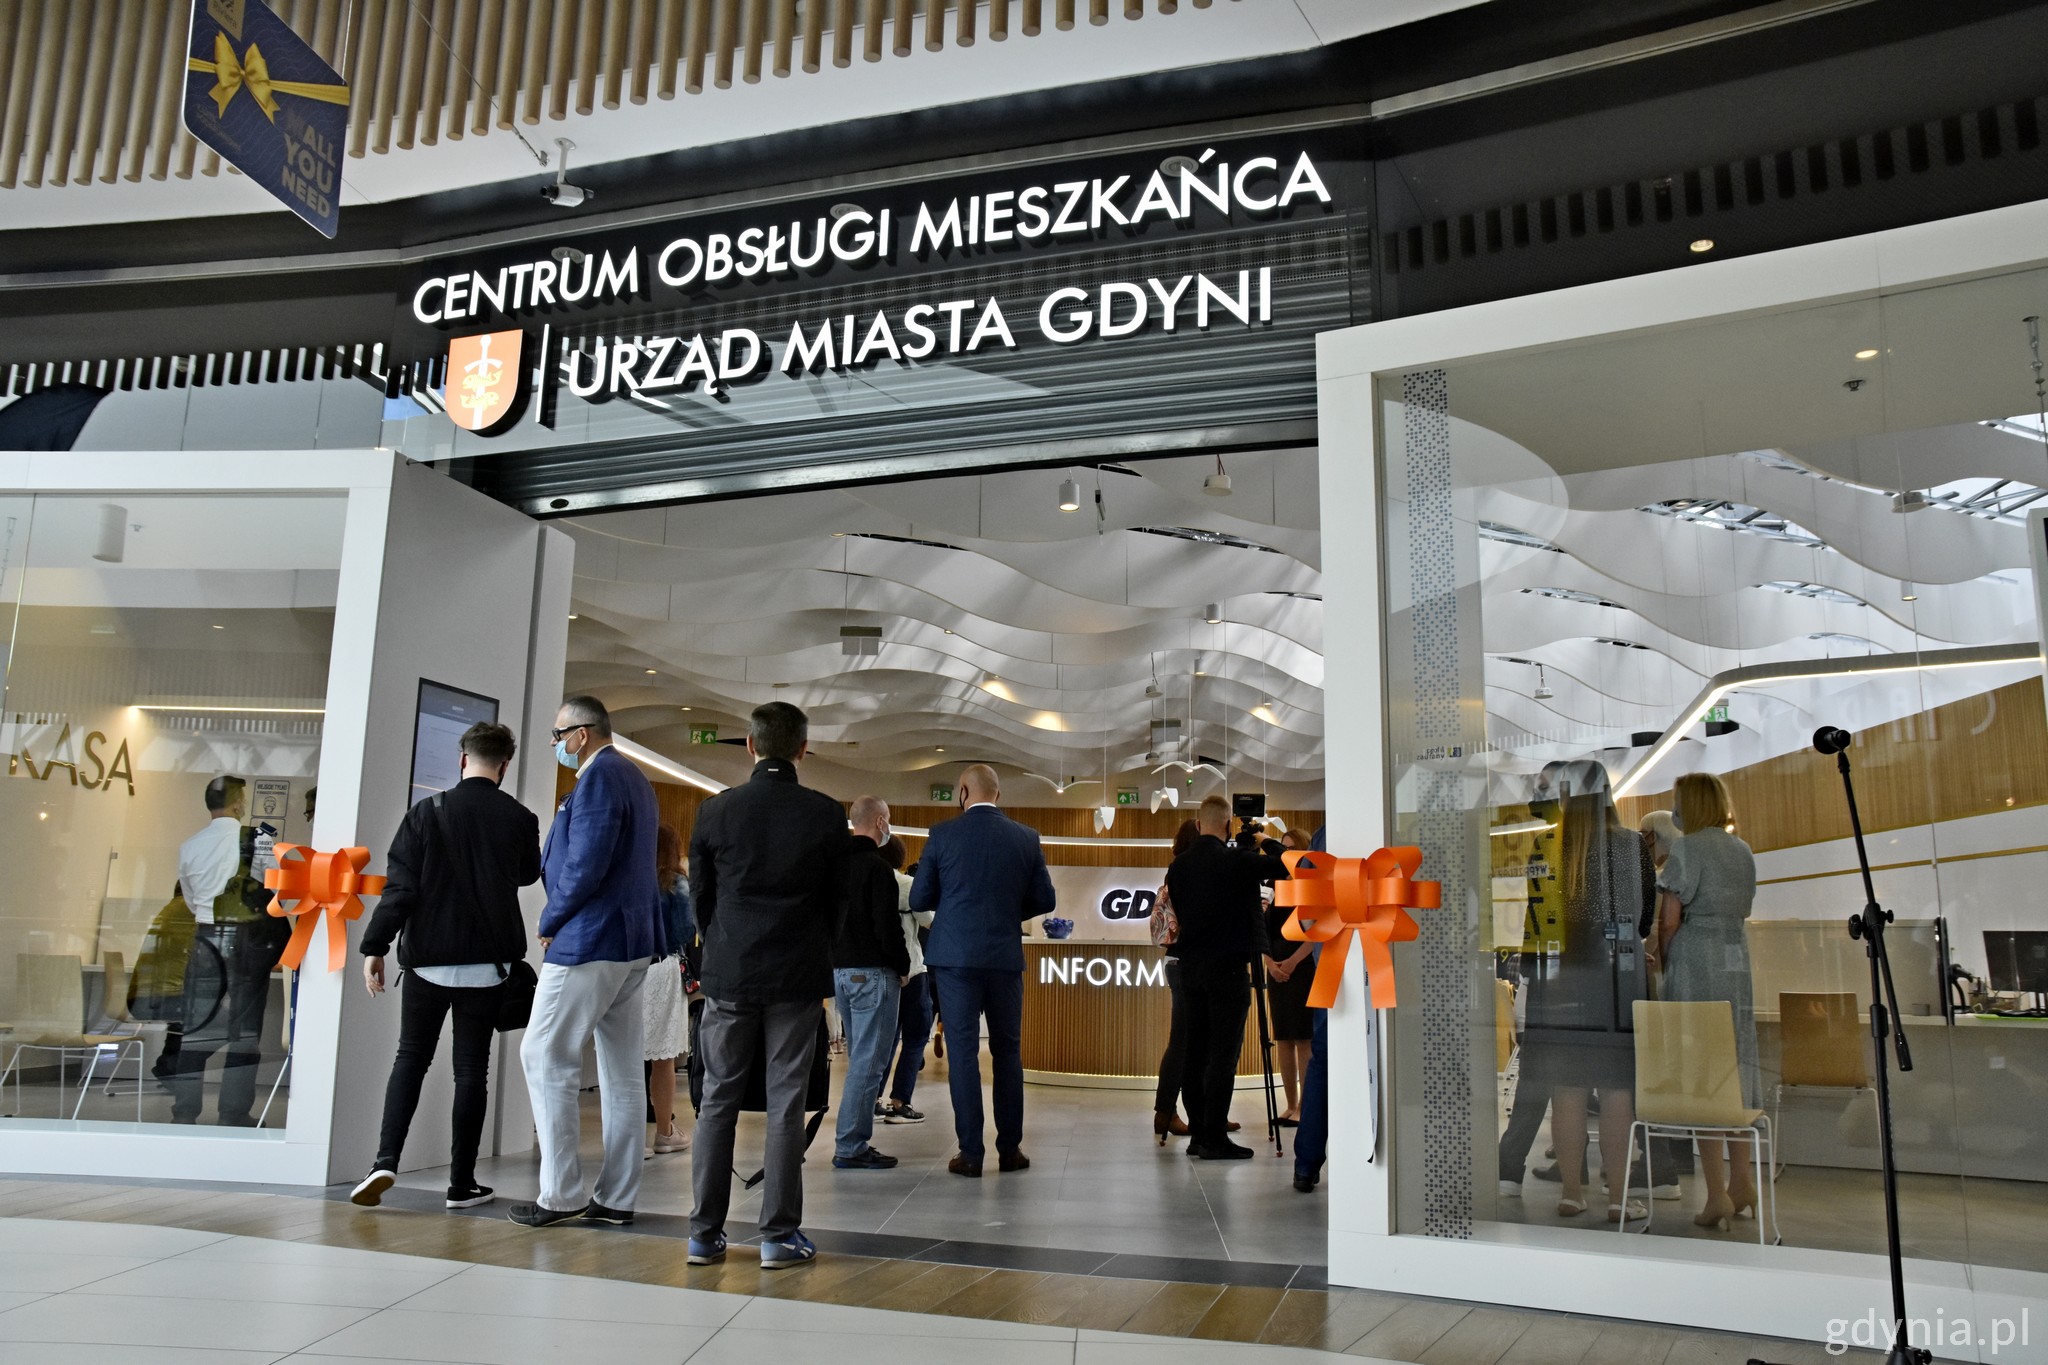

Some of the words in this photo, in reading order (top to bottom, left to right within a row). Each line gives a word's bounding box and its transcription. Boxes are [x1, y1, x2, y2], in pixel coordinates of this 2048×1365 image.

[284, 133, 333, 194] YOU
[302, 125, 336, 168] ALL
[282, 165, 331, 218] NEED
[413, 246, 638, 323] CENTRUM
[658, 207, 890, 286] OBSŁUGI
[910, 148, 1331, 253] MIESZKAŃCA
[569, 328, 760, 395] URZĄD
[781, 295, 1016, 372] MIASTA
[1039, 267, 1271, 343] GDYNI
[9, 714, 135, 796] KASA
[1040, 956, 1168, 987] INFORM
